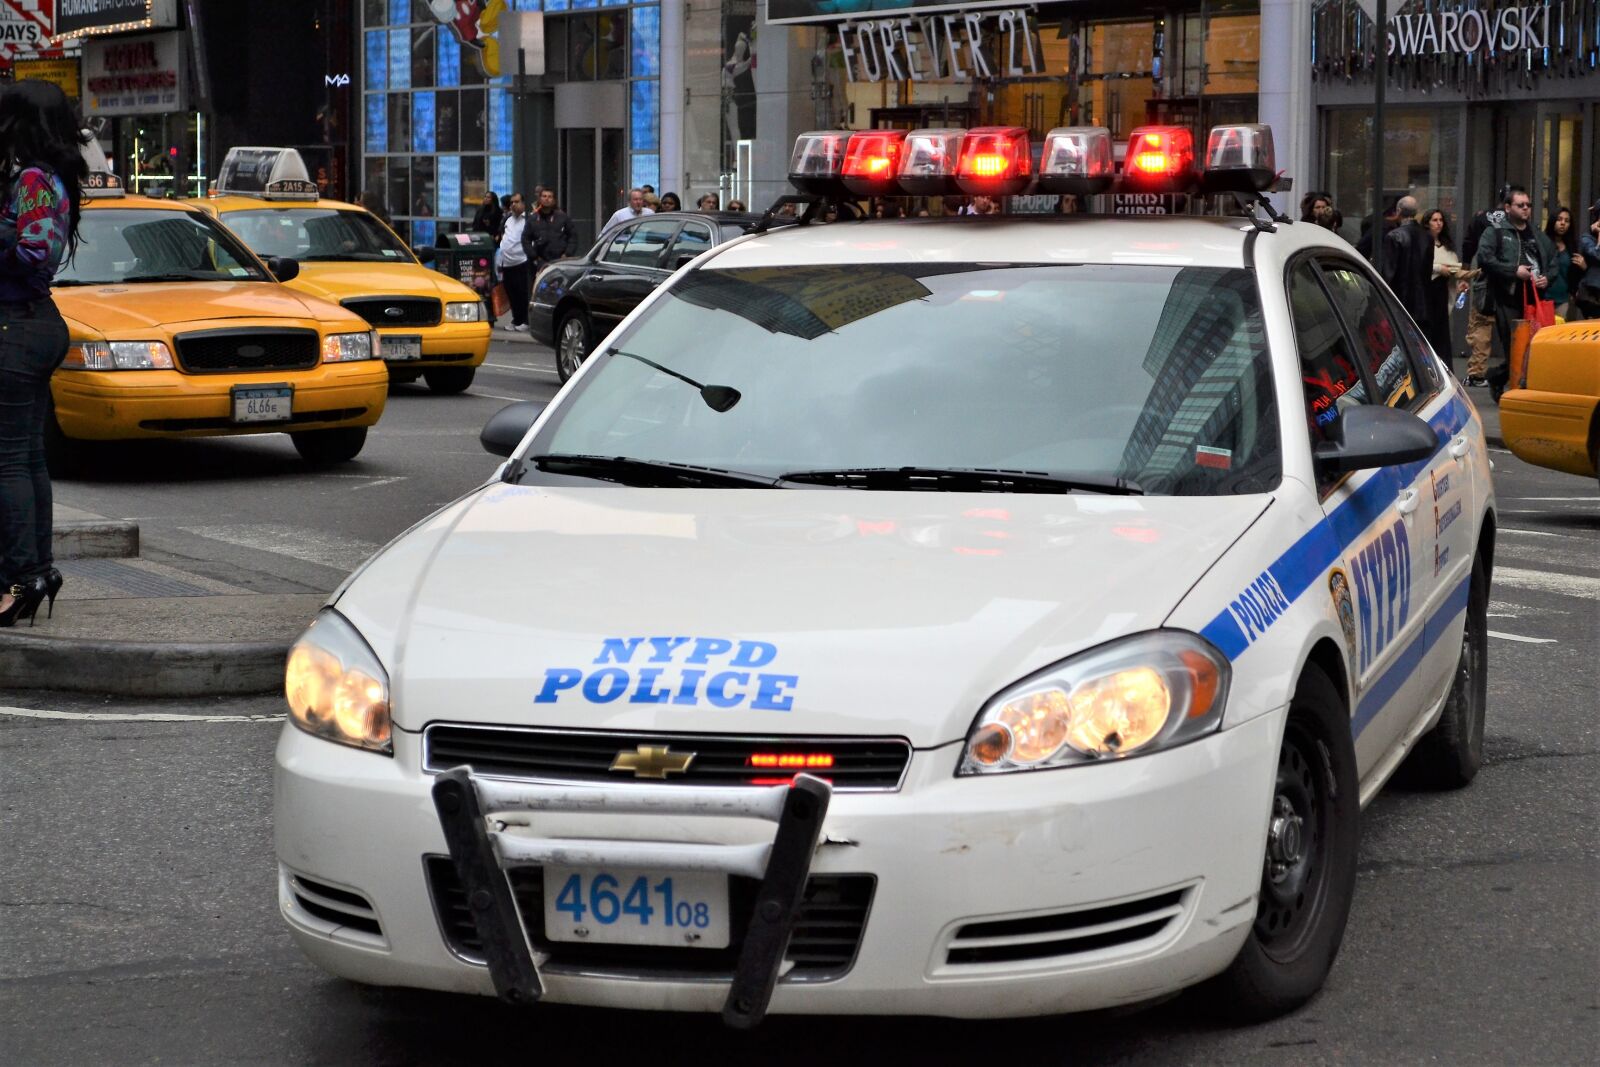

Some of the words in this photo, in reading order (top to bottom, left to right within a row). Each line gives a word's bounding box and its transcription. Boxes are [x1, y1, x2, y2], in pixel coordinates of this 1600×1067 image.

[837, 14, 992, 82] FOREVER
[999, 8, 1039, 77] 21
[1229, 570, 1290, 643] POLICE
[1350, 518, 1411, 677] NYPD
[533, 667, 799, 711] POLICE
[593, 637, 778, 668] NYPD
